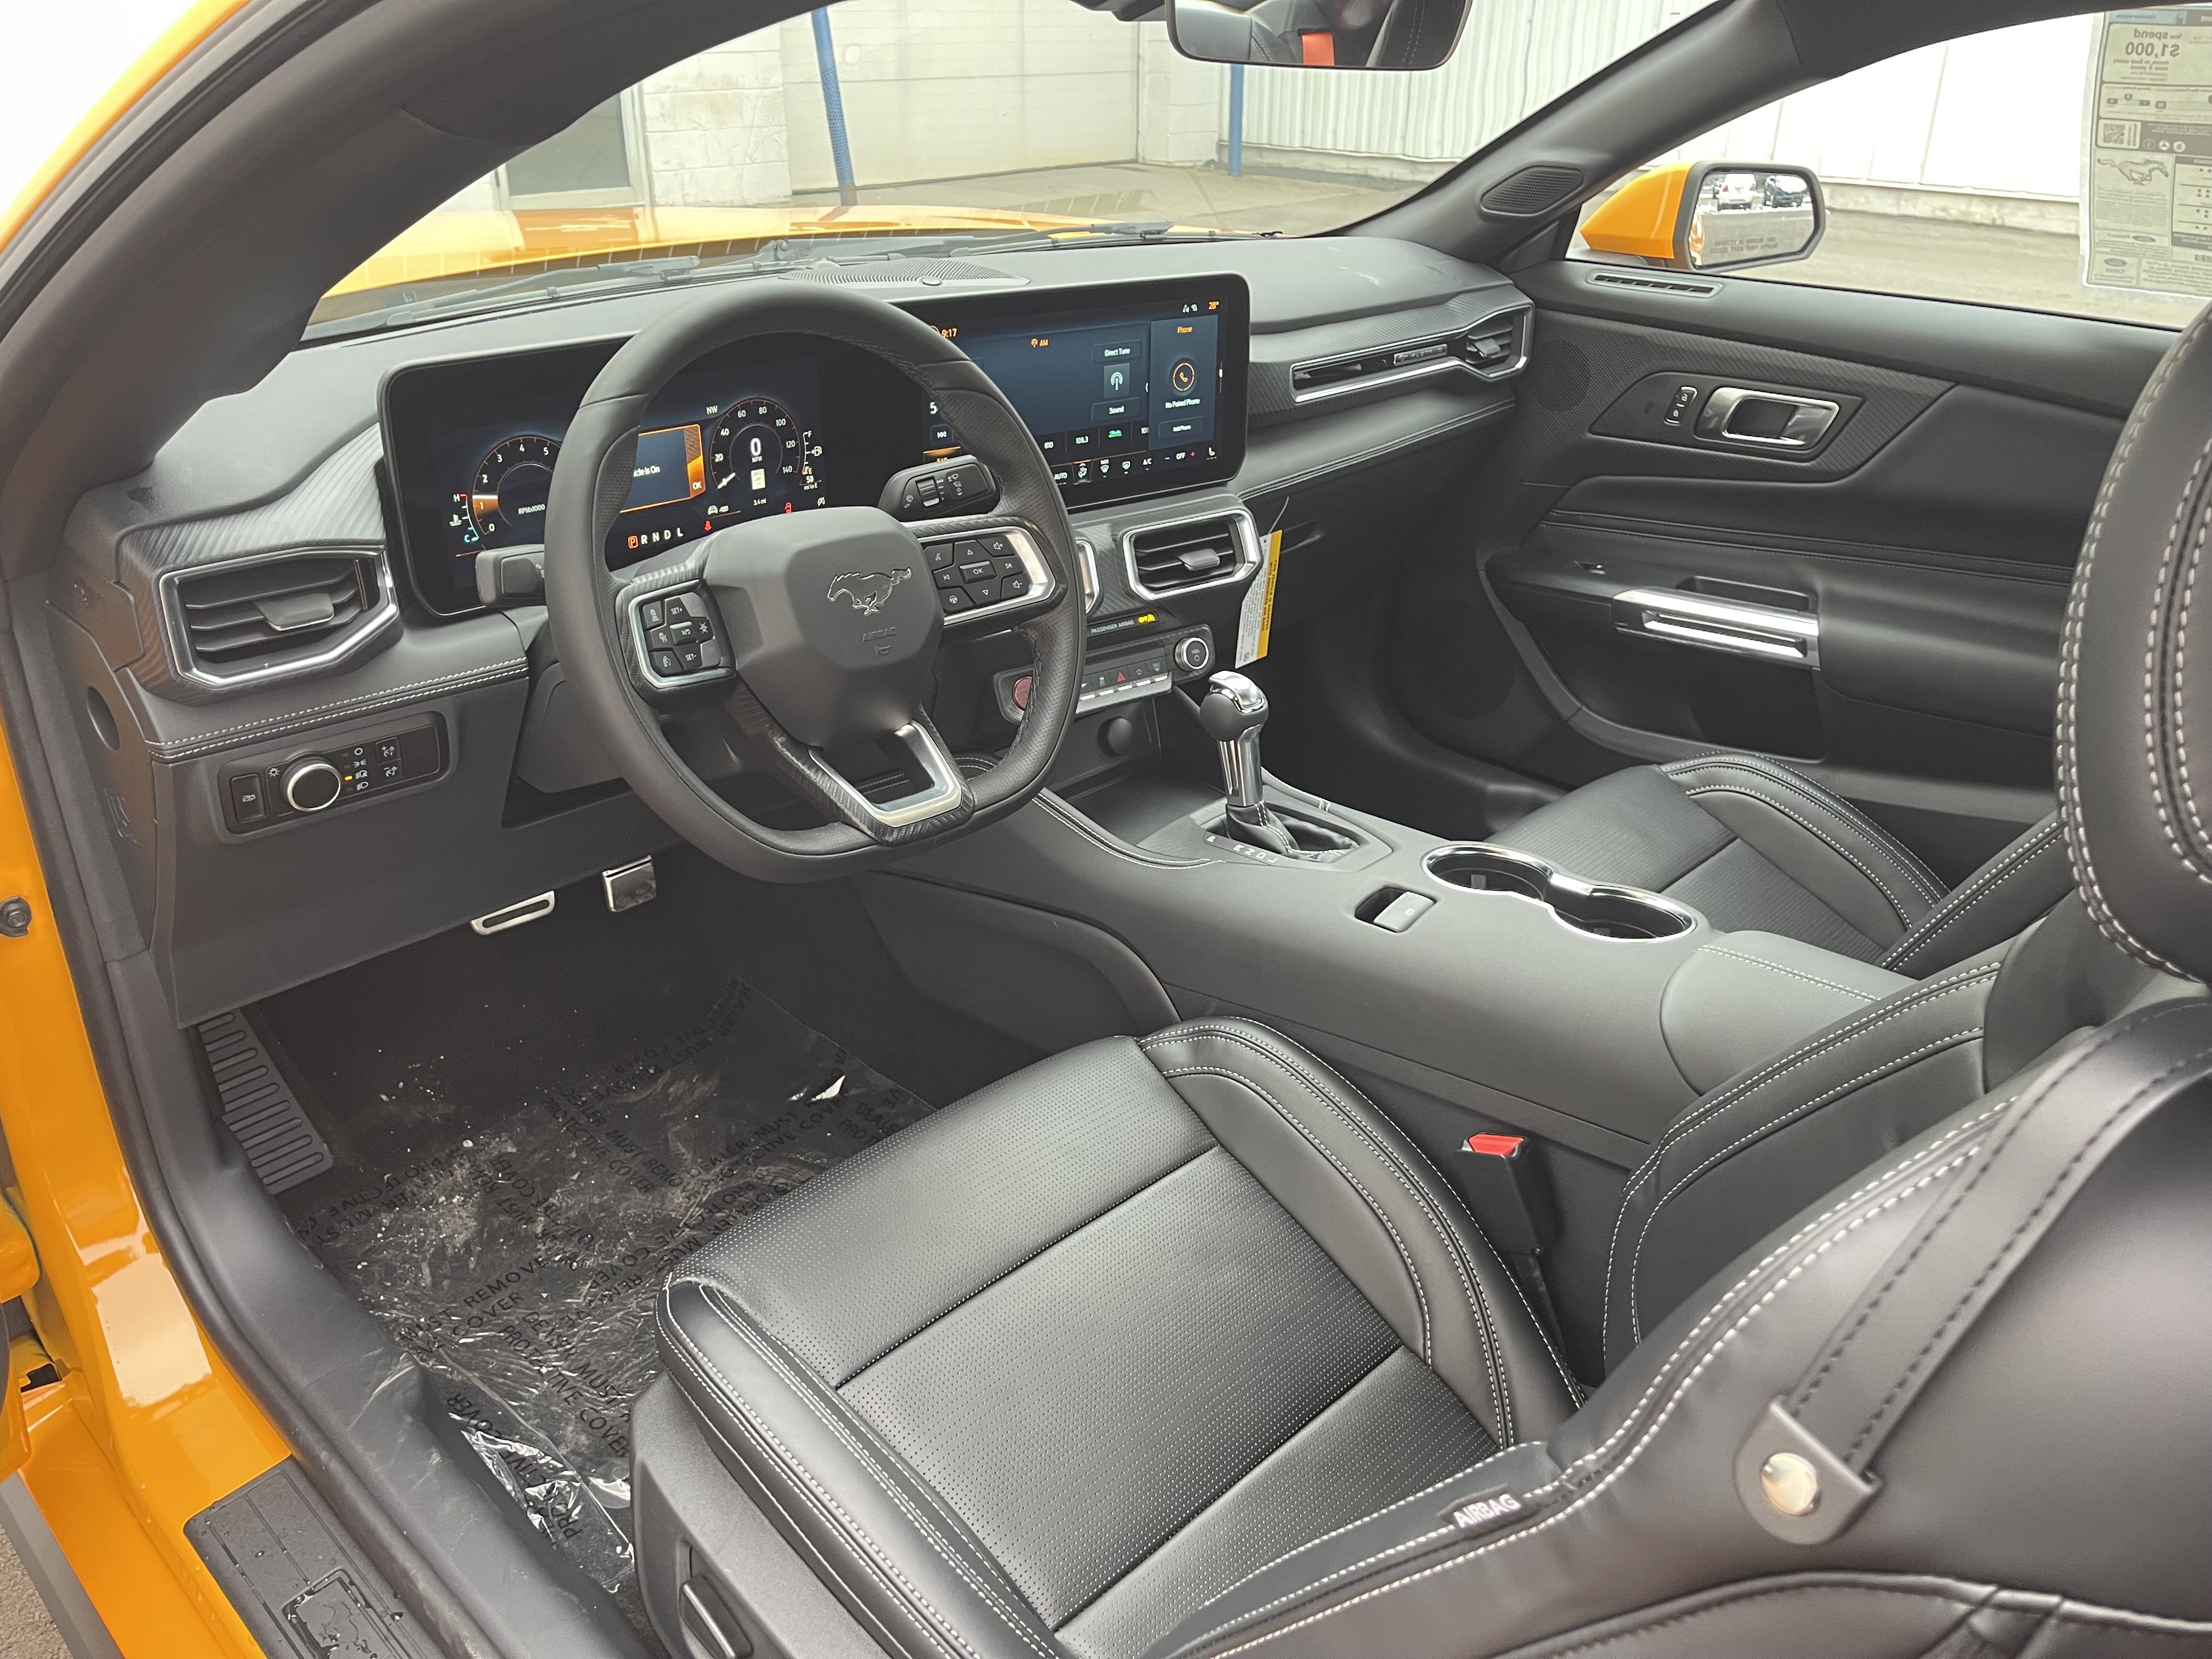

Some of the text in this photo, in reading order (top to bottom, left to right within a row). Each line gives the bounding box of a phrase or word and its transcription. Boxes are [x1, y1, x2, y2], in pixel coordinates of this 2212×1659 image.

[1208, 301, 1220, 310] 28°
[941, 328, 957, 338] 9:17
[1104, 349, 1118, 357] Direct
[706, 405, 718, 415] NW
[738, 410, 746, 418] 60
[1109, 405, 1125, 414] Sound
[720, 428, 730, 437] 40
[519, 444, 525, 452] 4
[751, 438, 761, 456] 0
[786, 440, 795, 449] 120
[543, 447, 549, 455] 5
[497, 454, 503, 462] 3
[714, 453, 724, 462] 20
[1176, 452, 1186, 460] OFF
[1142, 458, 1152, 466] A/C
[782, 465, 793, 473] 140
[482, 474, 488, 483] 2
[1054, 471, 1068, 480] AUTO
[692, 481, 702, 490] OK
[453, 494, 460, 502] H
[480, 501, 484, 510] 1
[488, 523, 495, 532] 0
[464, 534, 470, 543] C
[641, 534, 648, 544] R
[652, 532, 660, 543] N
[664, 529, 672, 539] D
[677, 527, 684, 537] L
[670, 606, 682, 615] SET+
[1091, 623, 1118, 634] PASSENGER
[1118, 619, 1135, 628] AIRBAG
[862, 627, 898, 642] AIRBAG
[560, 1087, 607, 1127] DEALER
[605, 1128, 648, 1159] MUST
[855, 1101, 901, 1136] DEALE
[754, 1110, 799, 1141] MUST
[539, 1098, 655, 1193] PROTECTIVE COVER
[463, 1255, 549, 1309] REMOVE
[452, 1291, 525, 1336] COVER
[1453, 1493, 1522, 1528] AIRBAG
